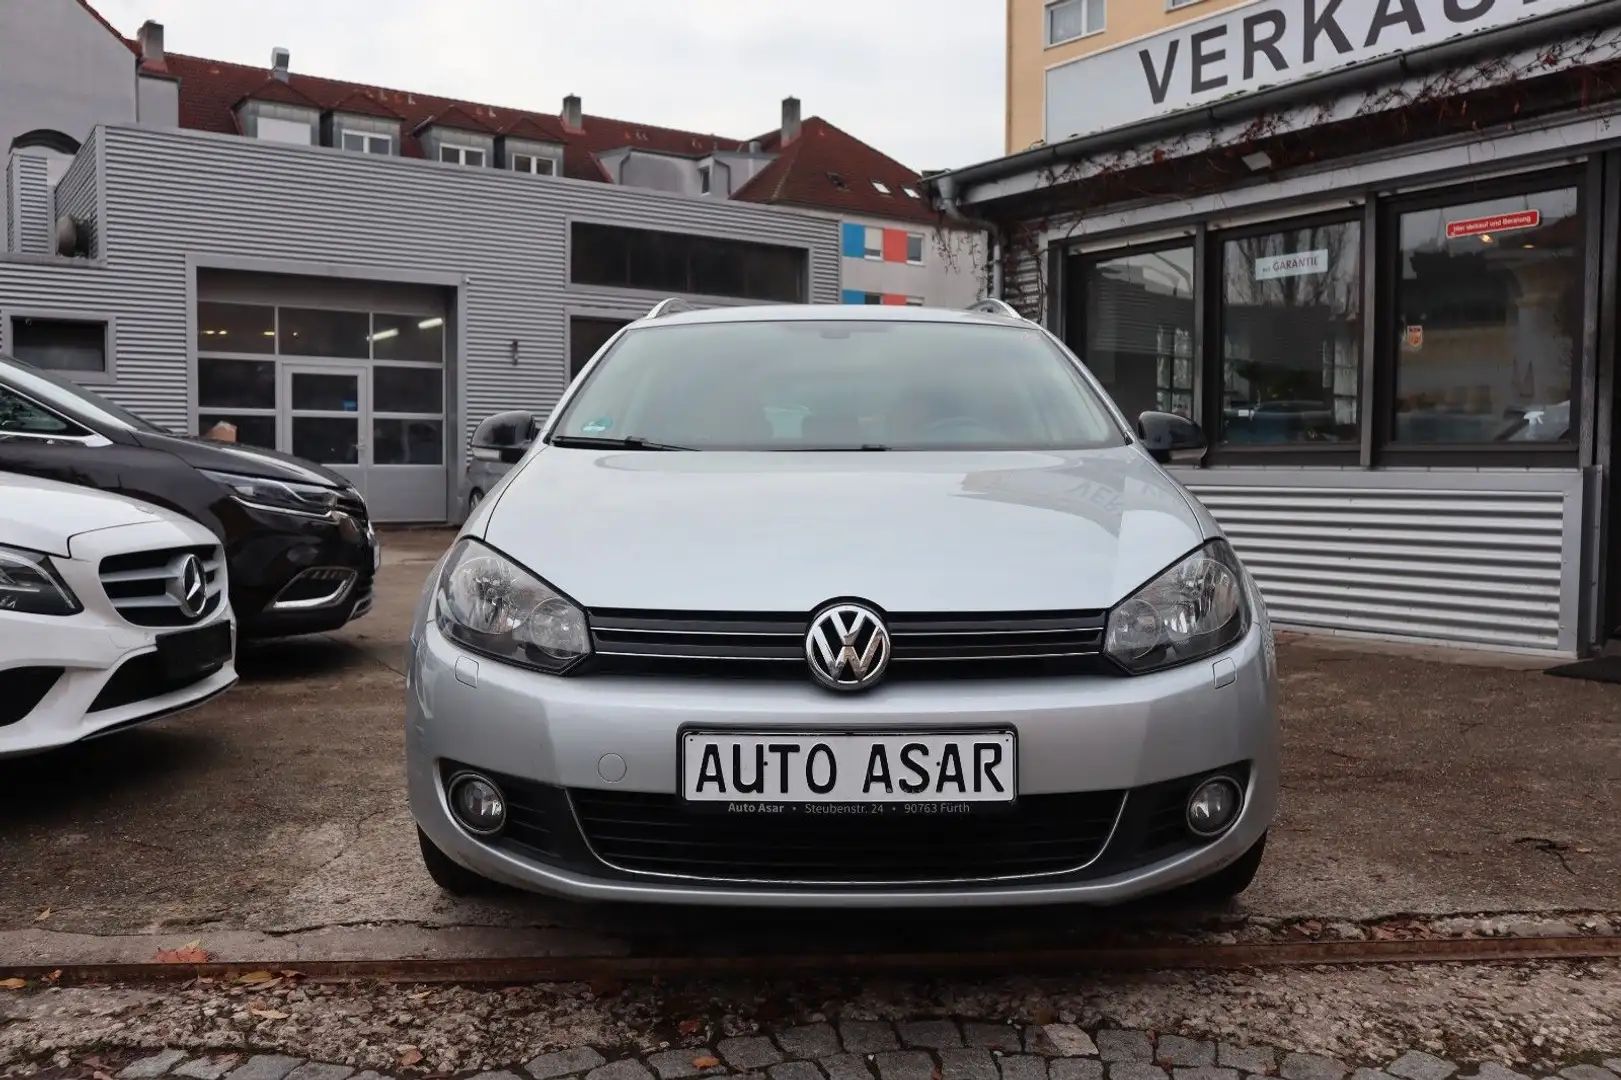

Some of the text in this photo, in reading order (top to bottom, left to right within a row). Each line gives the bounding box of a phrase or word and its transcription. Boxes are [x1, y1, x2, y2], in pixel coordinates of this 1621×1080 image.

[695, 742, 1005, 794] AUTO ASAR
[728, 802, 970, 814] Auto Asar Steubenstr. 24 90763 Fürth
